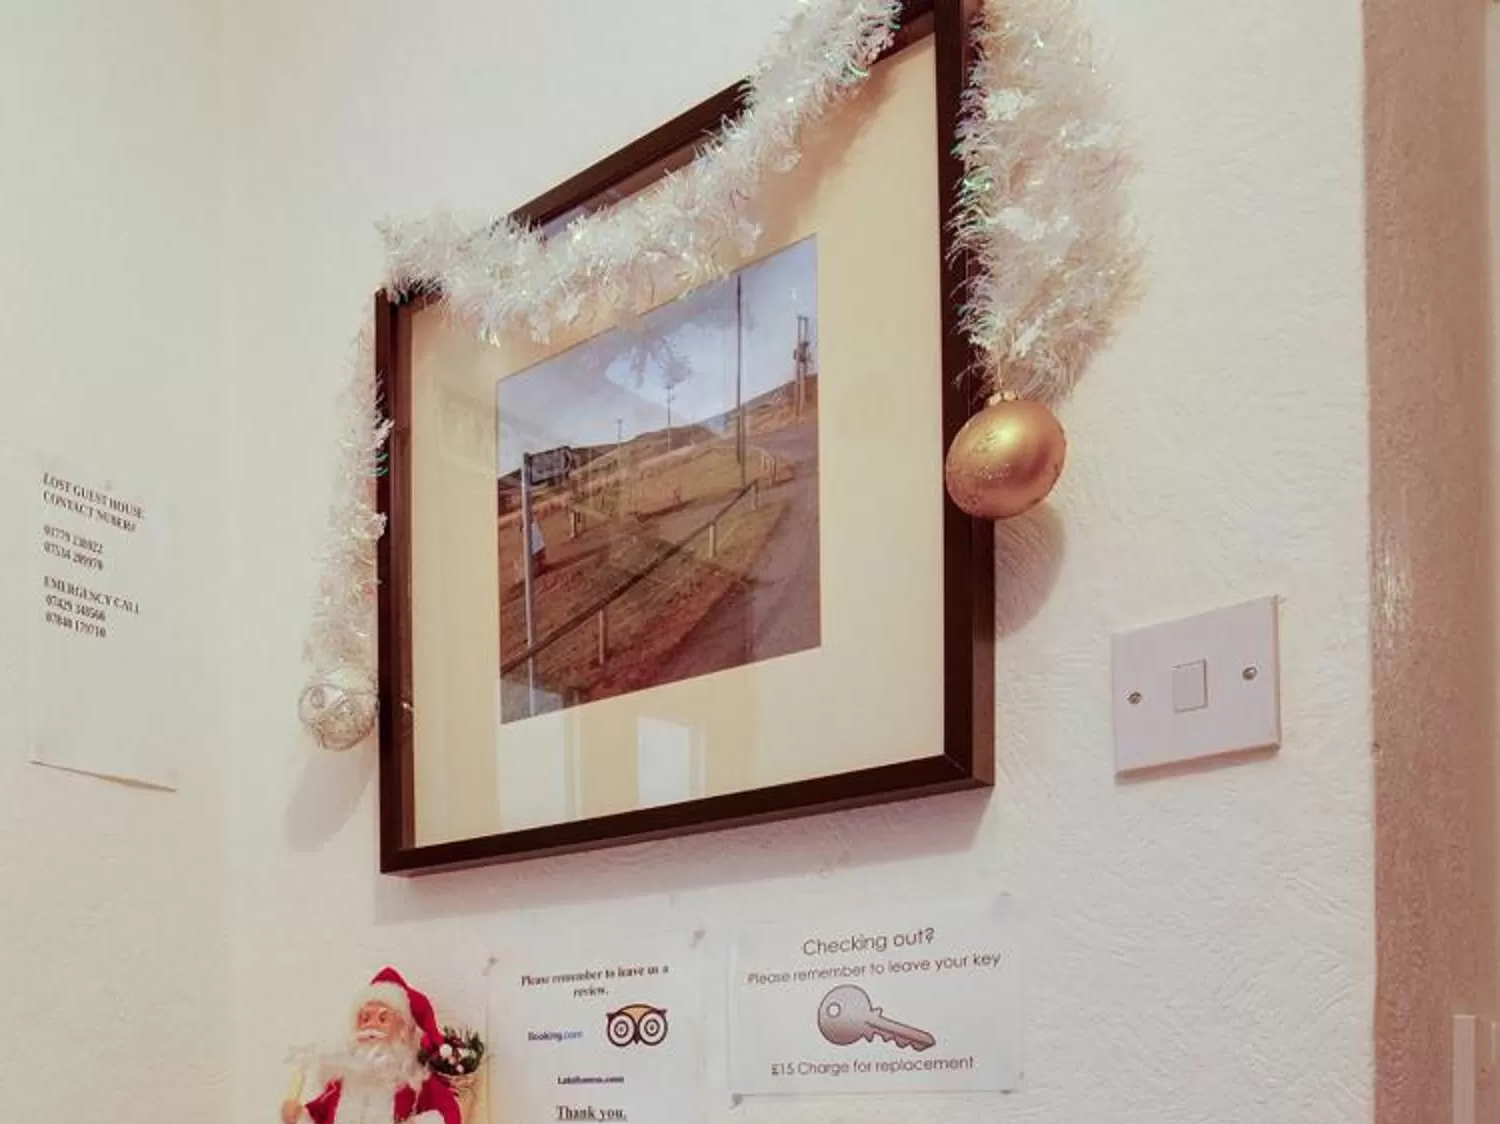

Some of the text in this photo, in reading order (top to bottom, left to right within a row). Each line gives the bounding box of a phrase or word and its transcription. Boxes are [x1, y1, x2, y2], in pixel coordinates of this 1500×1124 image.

[43, 491, 94, 517] CONTACT
[73, 485, 107, 506] GUEST
[109, 498, 144, 520] HOUSE
[43, 576, 139, 614] EMERGENCY CALL
[803, 927, 935, 956] Checking out?
[520, 965, 669, 987] Please remember to leave us a
[748, 952, 1001, 985] Please remember to leave your key
[771, 1056, 975, 1077] £15 Charge for replacement
[556, 1105, 628, 1123] Thank you.
